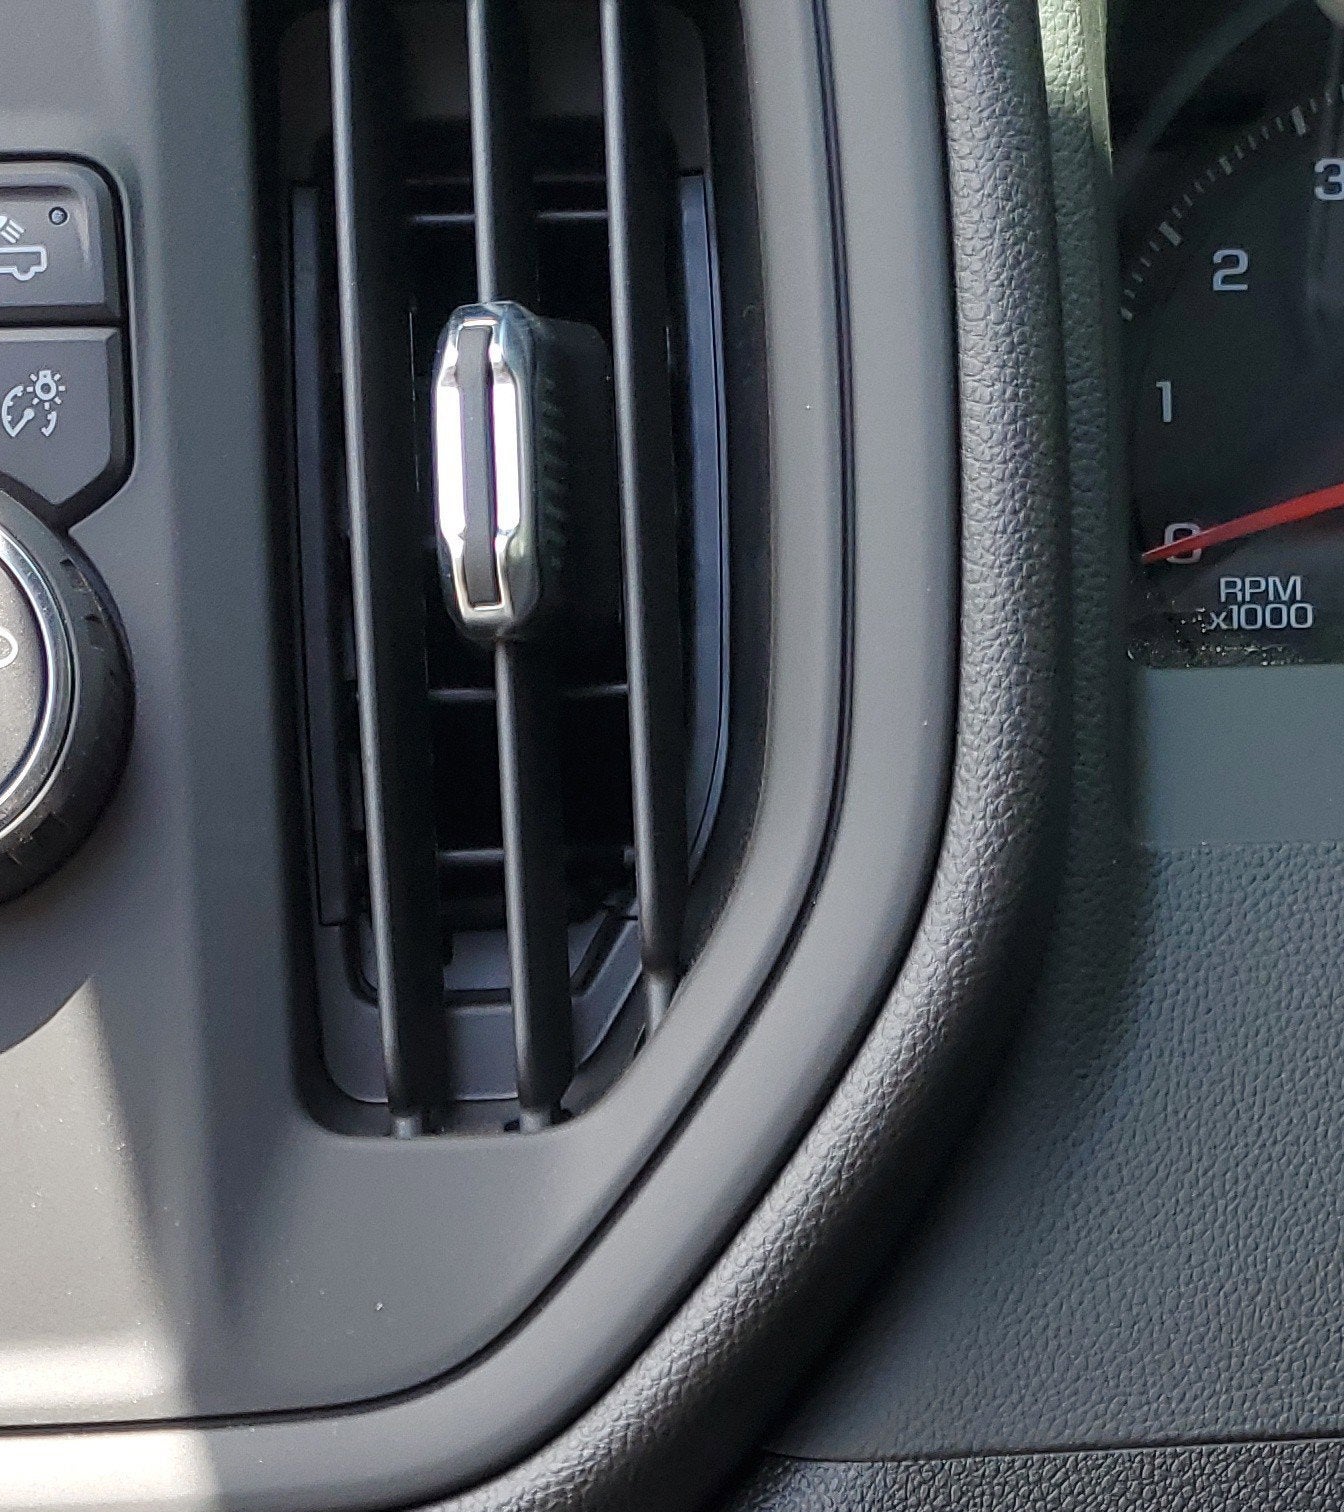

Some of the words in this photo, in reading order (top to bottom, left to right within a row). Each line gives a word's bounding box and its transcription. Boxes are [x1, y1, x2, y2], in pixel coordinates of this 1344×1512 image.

[1212, 249, 1249, 291] 2
[1156, 380, 1172, 423] 1
[1219, 575, 1302, 602] RPM
